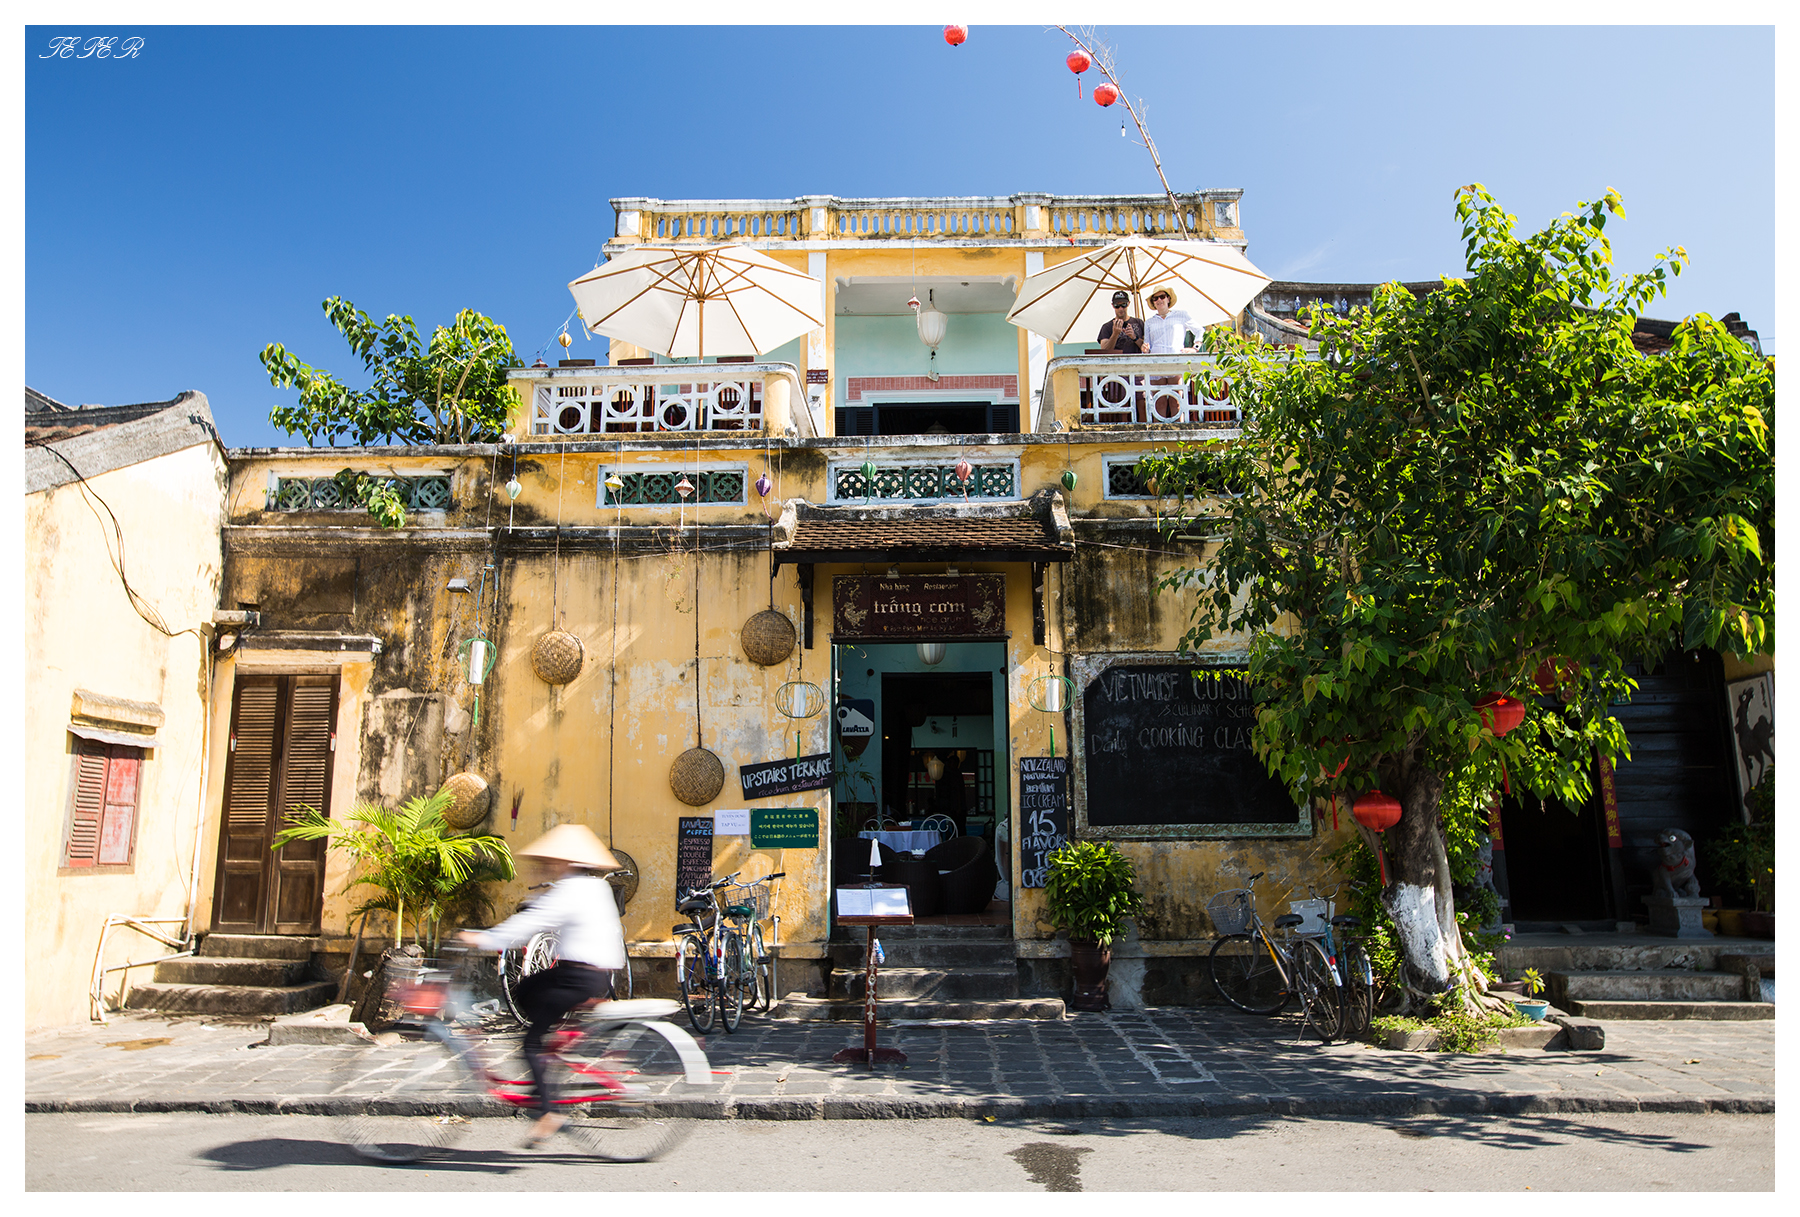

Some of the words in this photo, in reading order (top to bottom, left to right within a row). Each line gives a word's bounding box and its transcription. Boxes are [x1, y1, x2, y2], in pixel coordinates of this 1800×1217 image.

[843, 724, 869, 732] LAVAZZA
[1213, 726, 1254, 751] CLAS
[788, 757, 832, 780] TERRACE
[1022, 794, 1037, 809] ICE
[1038, 792, 1066, 808] CREAM
[1028, 808, 1058, 837] 15
[683, 838, 711, 846] ESPRESSO
